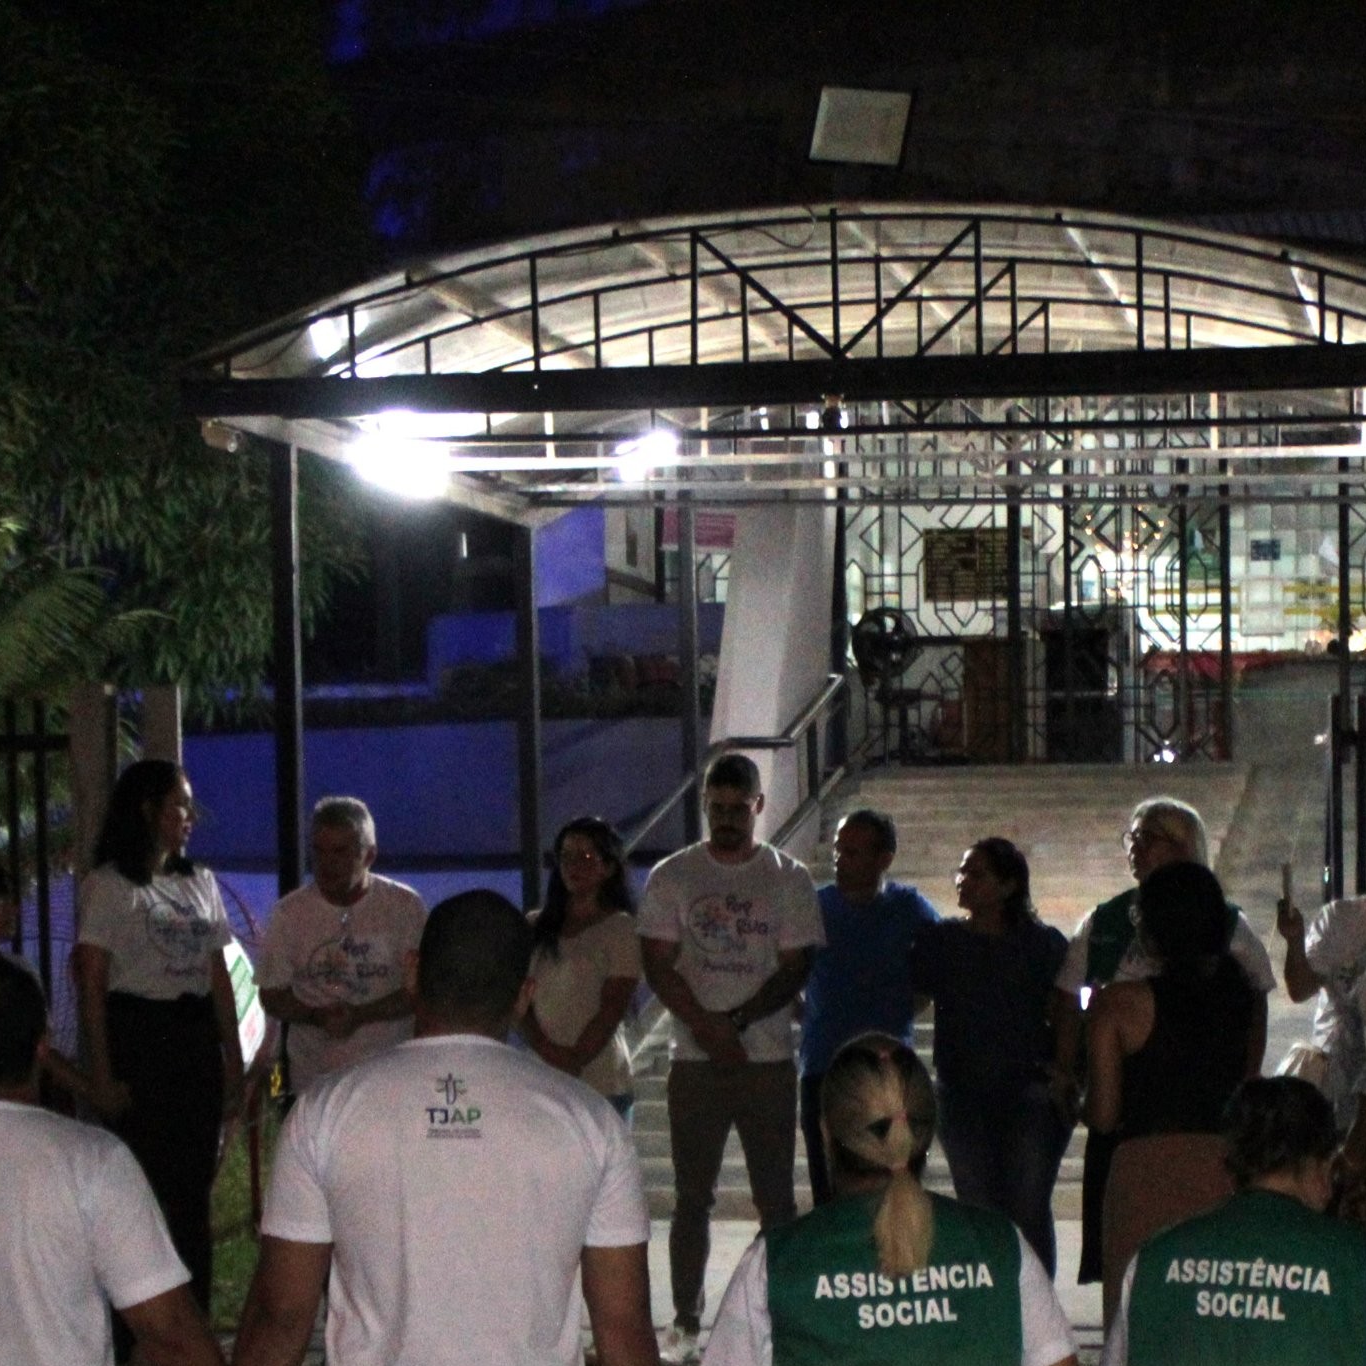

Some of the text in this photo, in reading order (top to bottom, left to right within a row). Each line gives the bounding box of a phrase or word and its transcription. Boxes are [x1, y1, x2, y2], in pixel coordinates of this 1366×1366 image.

[426, 1108, 481, 1124] TJAP
[1165, 1257, 1331, 1296] ASSISTÊNCIA
[858, 1297, 958, 1330] SOCIAL
[1196, 1290, 1286, 1321] SOCIAL
